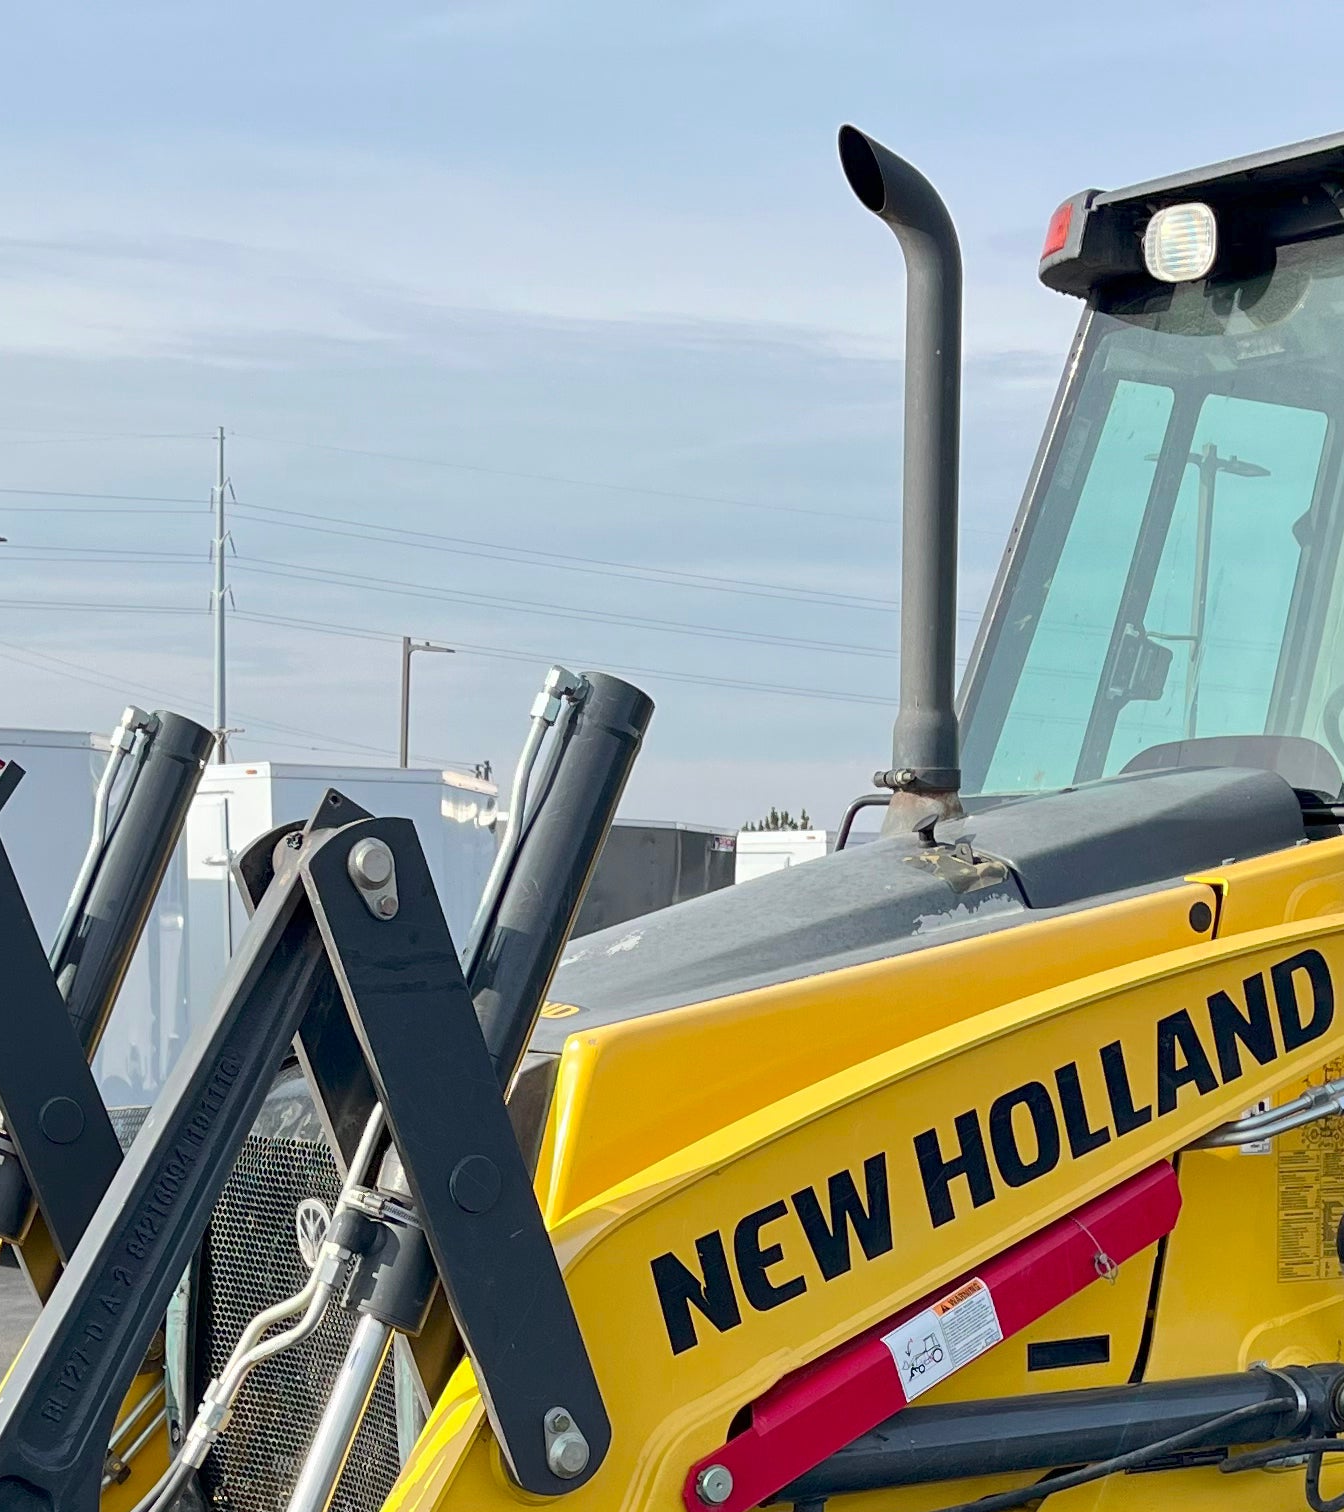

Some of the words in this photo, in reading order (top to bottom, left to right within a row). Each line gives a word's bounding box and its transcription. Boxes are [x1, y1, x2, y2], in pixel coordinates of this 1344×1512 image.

[650, 1152, 894, 1356] NEW
[913, 949, 1335, 1229] HOLLAND
[949, 1282, 981, 1307] WARNING
